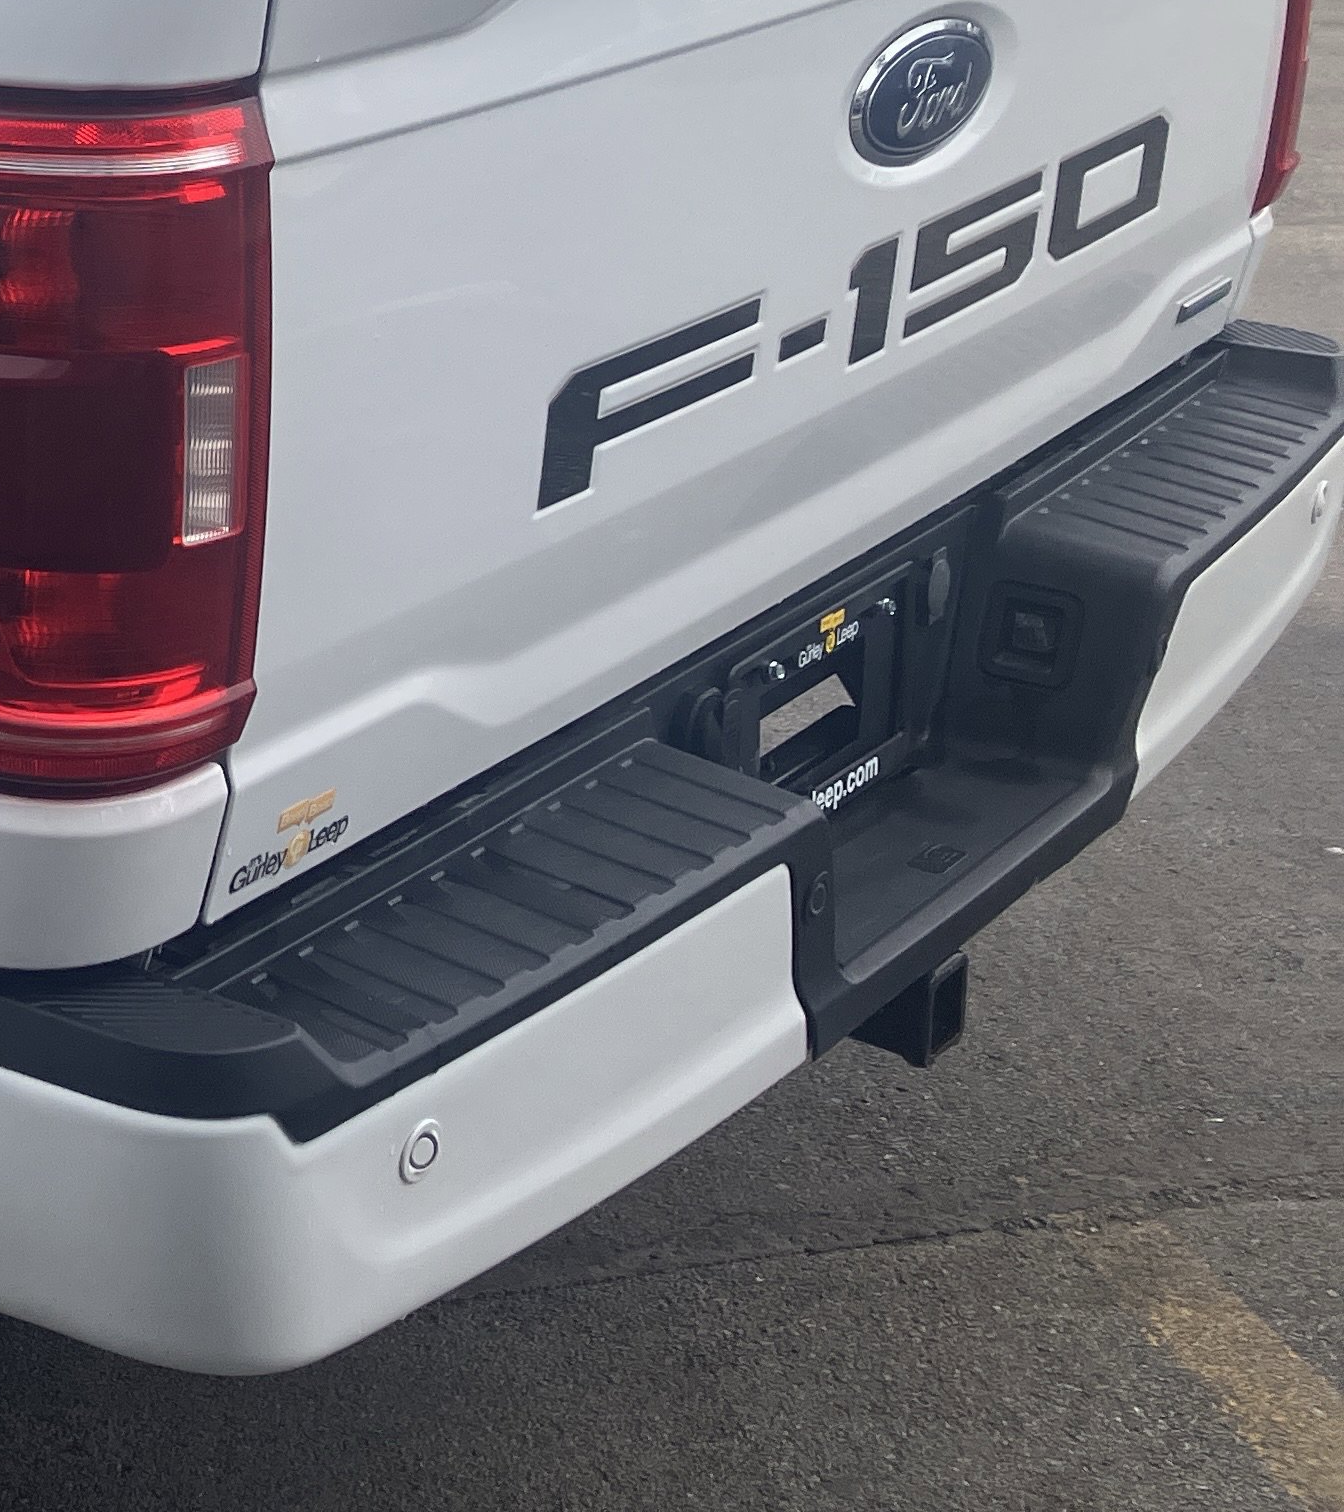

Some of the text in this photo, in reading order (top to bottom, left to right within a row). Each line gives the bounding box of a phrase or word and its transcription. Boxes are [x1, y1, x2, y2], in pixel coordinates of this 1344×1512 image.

[895, 51, 973, 140] Ford
[534, 113, 1171, 513] F-150
[228, 815, 349, 894] Gurley Leep
